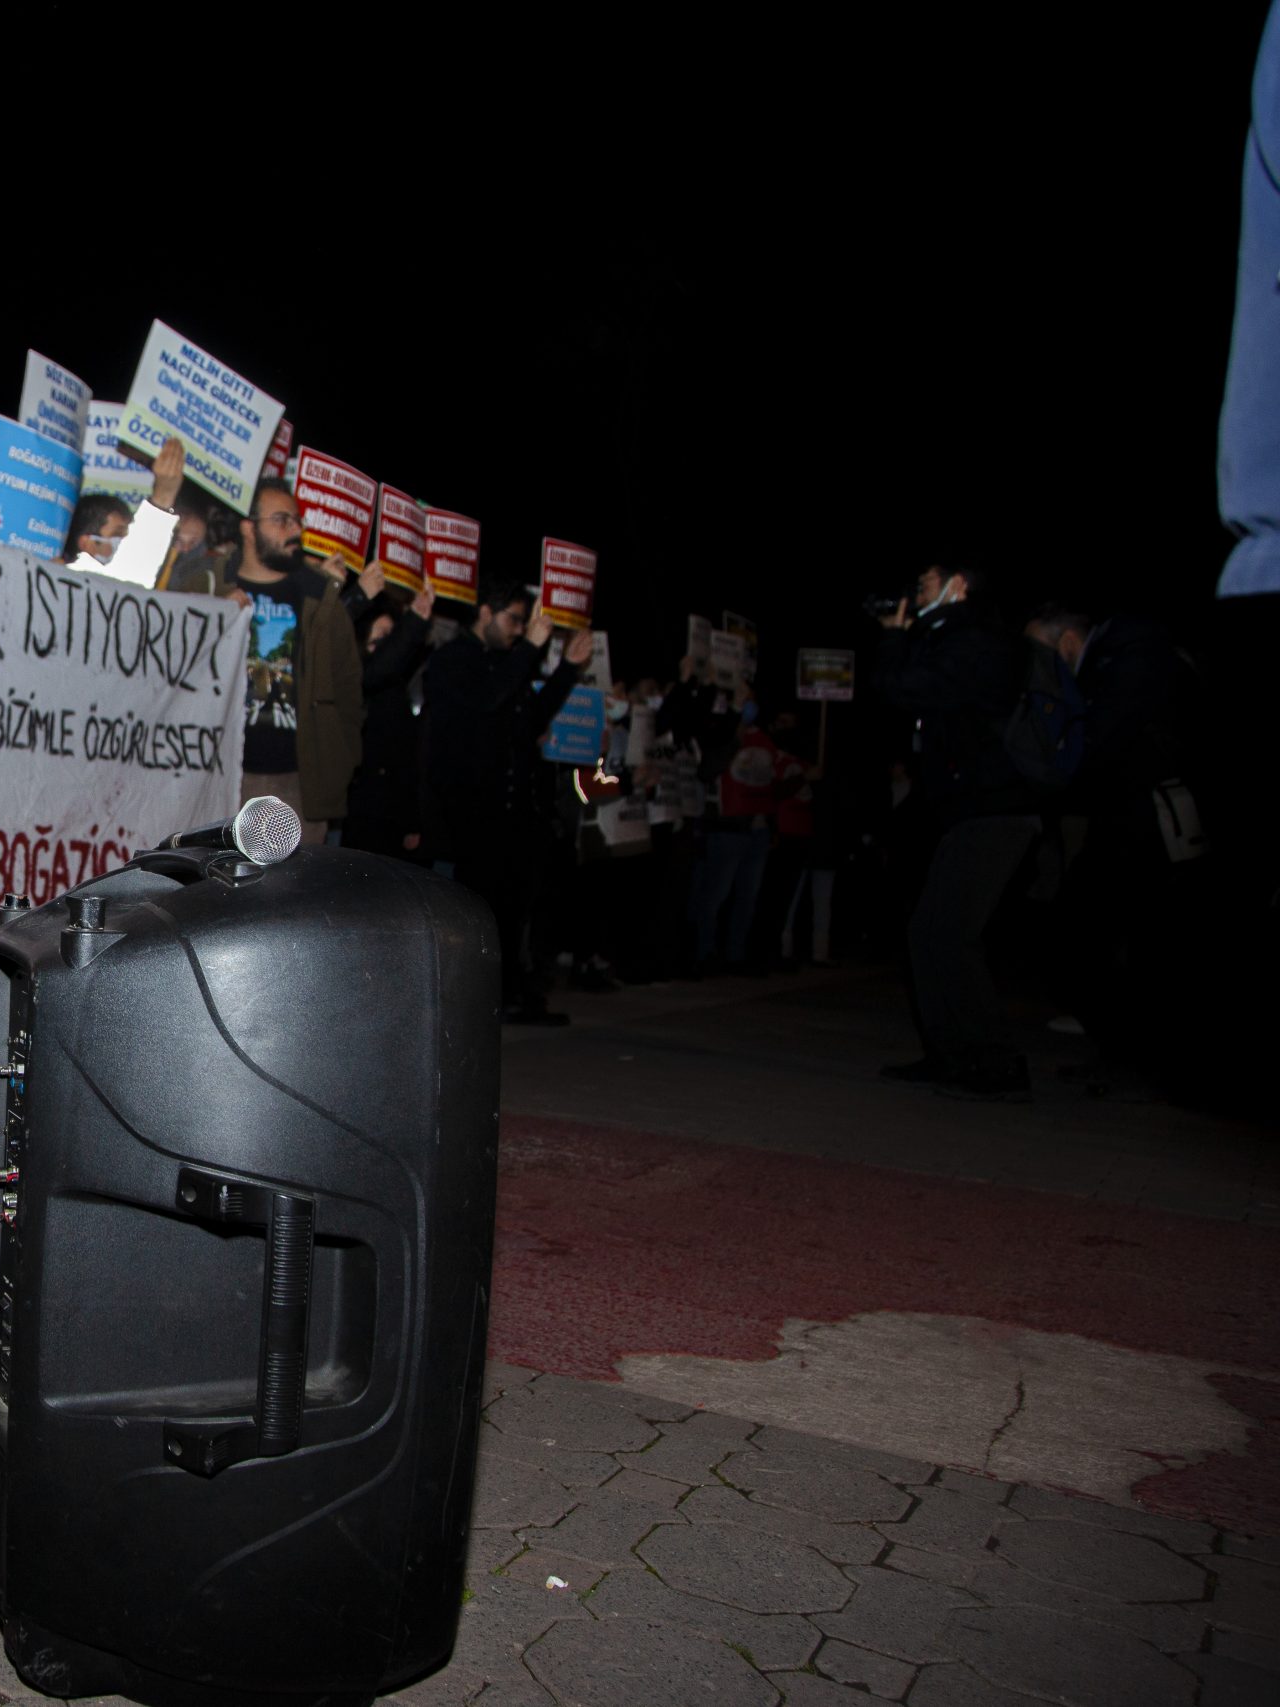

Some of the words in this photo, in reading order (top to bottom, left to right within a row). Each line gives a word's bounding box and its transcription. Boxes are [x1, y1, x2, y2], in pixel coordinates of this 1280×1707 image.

[159, 350, 192, 379] NACİ
[191, 373, 210, 391] DE
[210, 384, 263, 428] GİDECEK
[180, 342, 220, 378] MELİH
[220, 371, 257, 401] GİTTİ
[184, 452, 244, 500] BOĞAZİÇİ
[24, 558, 224, 696] İSTİYORUZ!
